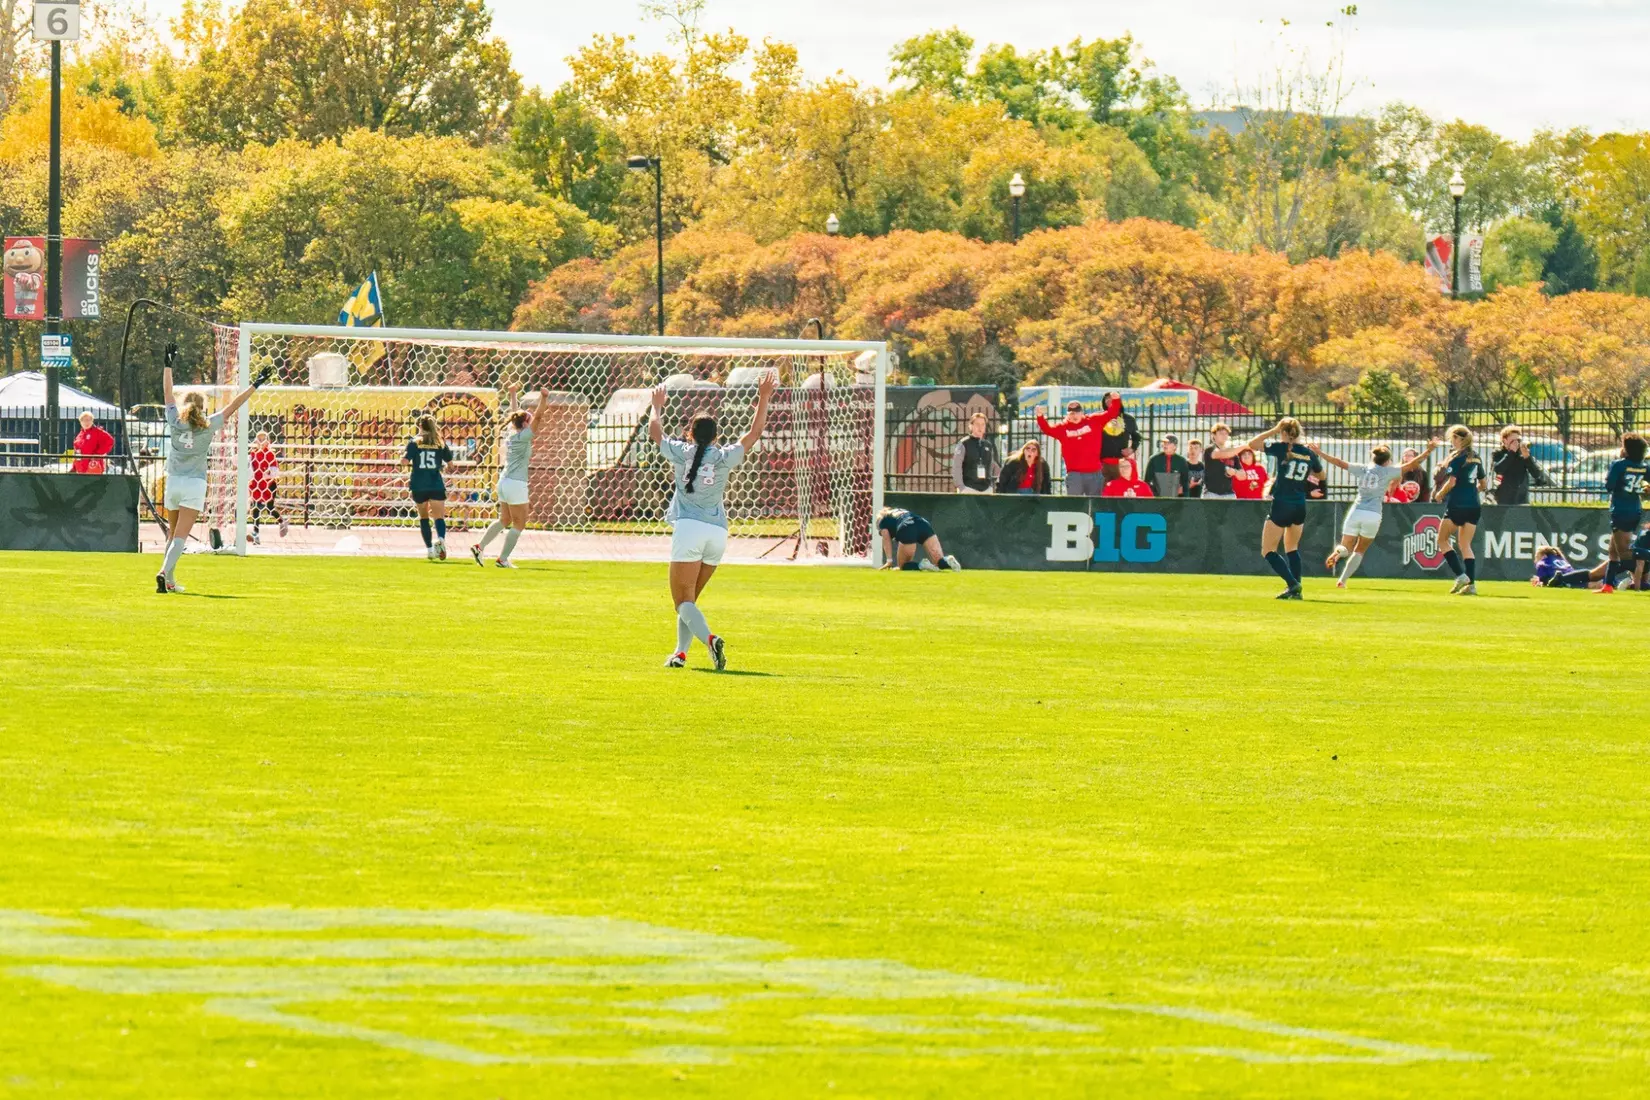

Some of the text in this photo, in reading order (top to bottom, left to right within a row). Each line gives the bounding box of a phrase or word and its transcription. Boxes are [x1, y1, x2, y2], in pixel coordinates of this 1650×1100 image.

[47, 8, 68, 35] 6
[81, 300, 87, 315] GO
[63, 336, 69, 345] P
[178, 431, 193, 449] 4
[419, 451, 437, 469] 15
[1285, 461, 1309, 480] 19
[1624, 474, 1646, 492] 34
